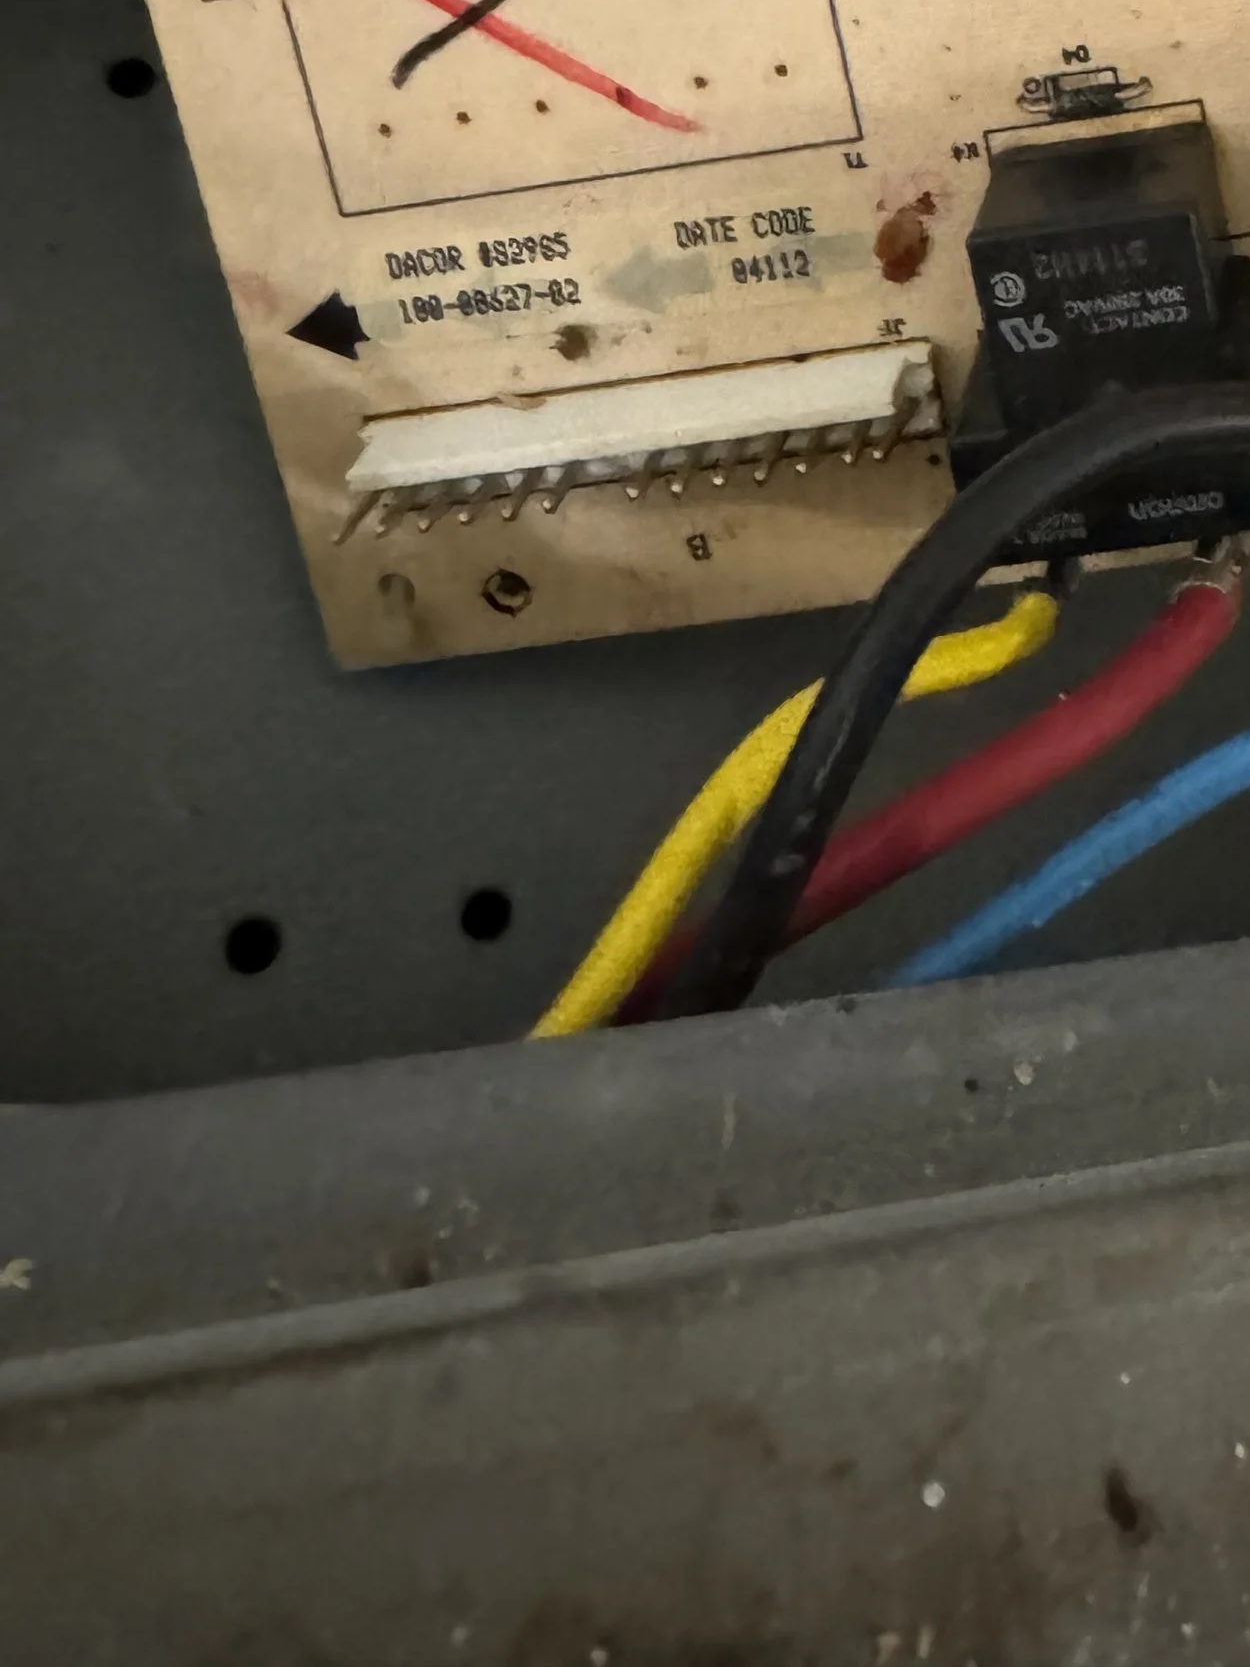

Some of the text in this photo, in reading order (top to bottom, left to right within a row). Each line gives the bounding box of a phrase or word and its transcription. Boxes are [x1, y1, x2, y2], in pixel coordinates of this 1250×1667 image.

[673, 206, 817, 250] DATE CODE
[385, 245, 465, 280] DACOR
